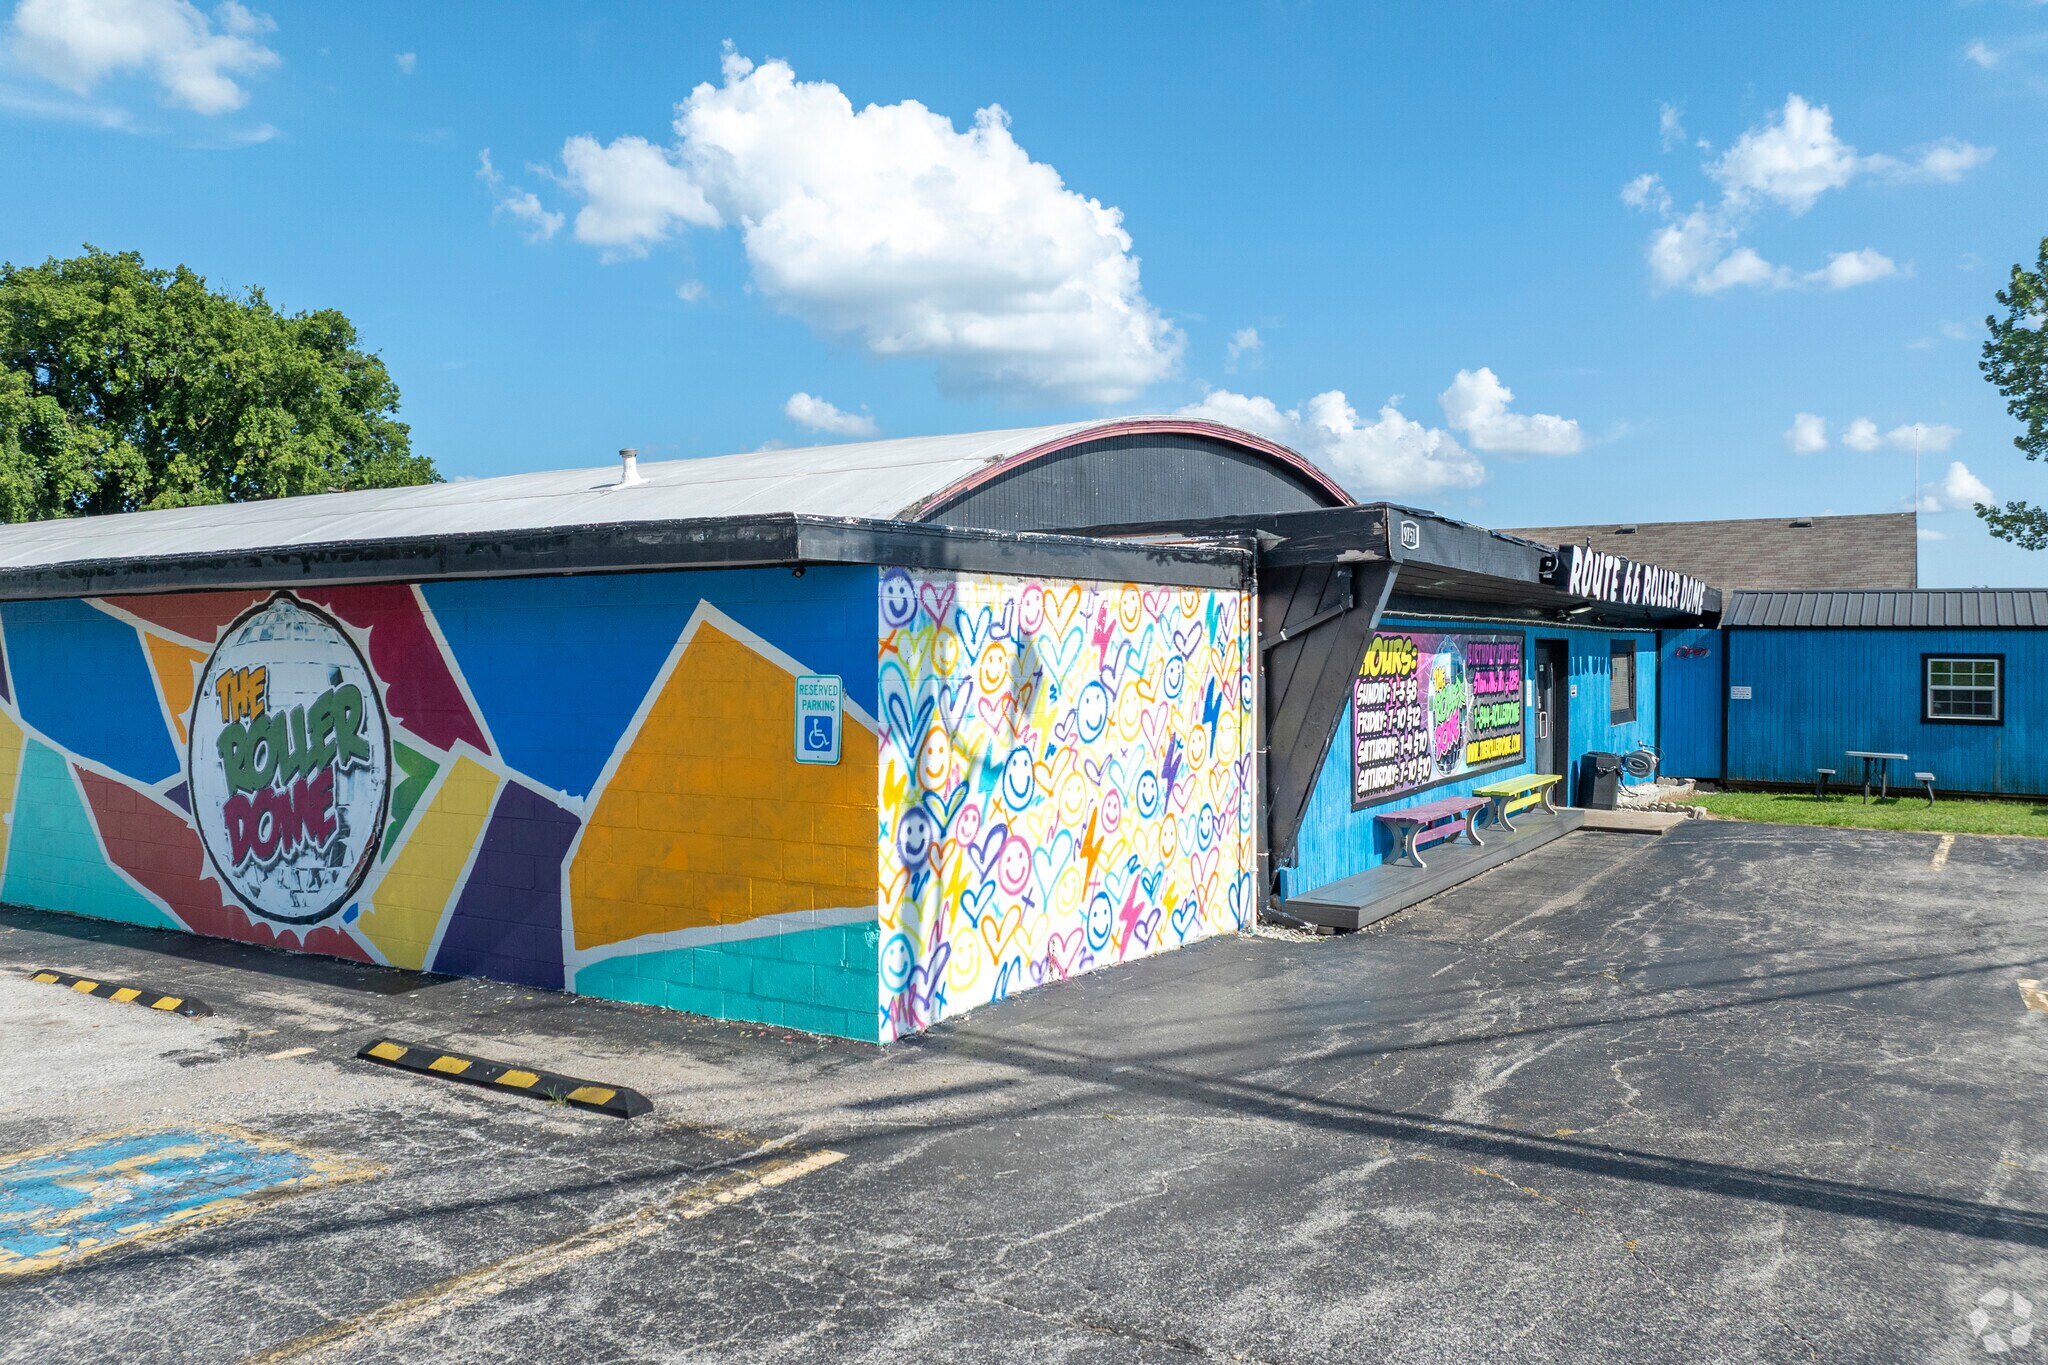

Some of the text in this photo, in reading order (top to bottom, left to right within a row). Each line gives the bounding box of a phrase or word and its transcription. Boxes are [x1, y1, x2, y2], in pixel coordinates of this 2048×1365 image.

[1568, 544, 1706, 616] ROUTE 66 ROLLER DOME
[1467, 643, 1519, 665] BIRTHDAY PARTIES
[215, 665, 267, 725] THE
[799, 684, 838, 696] RESERVED
[1357, 677, 1418, 706] SUNDAY: 1-3 $8
[1433, 666, 1446, 692] THE
[802, 699, 835, 711] PARKING
[1434, 673, 1466, 724] ROLLER
[1357, 703, 1421, 735] FRIDAY: 7-10 $12
[1435, 707, 1460, 761] DOME
[215, 683, 371, 796] ROLLER
[1357, 736, 1399, 764] SATURDAY:
[1413, 729, 1429, 757] $10
[1357, 754, 1432, 794] SATURDAY: 7-10 $10
[222, 767, 338, 869] DOME
